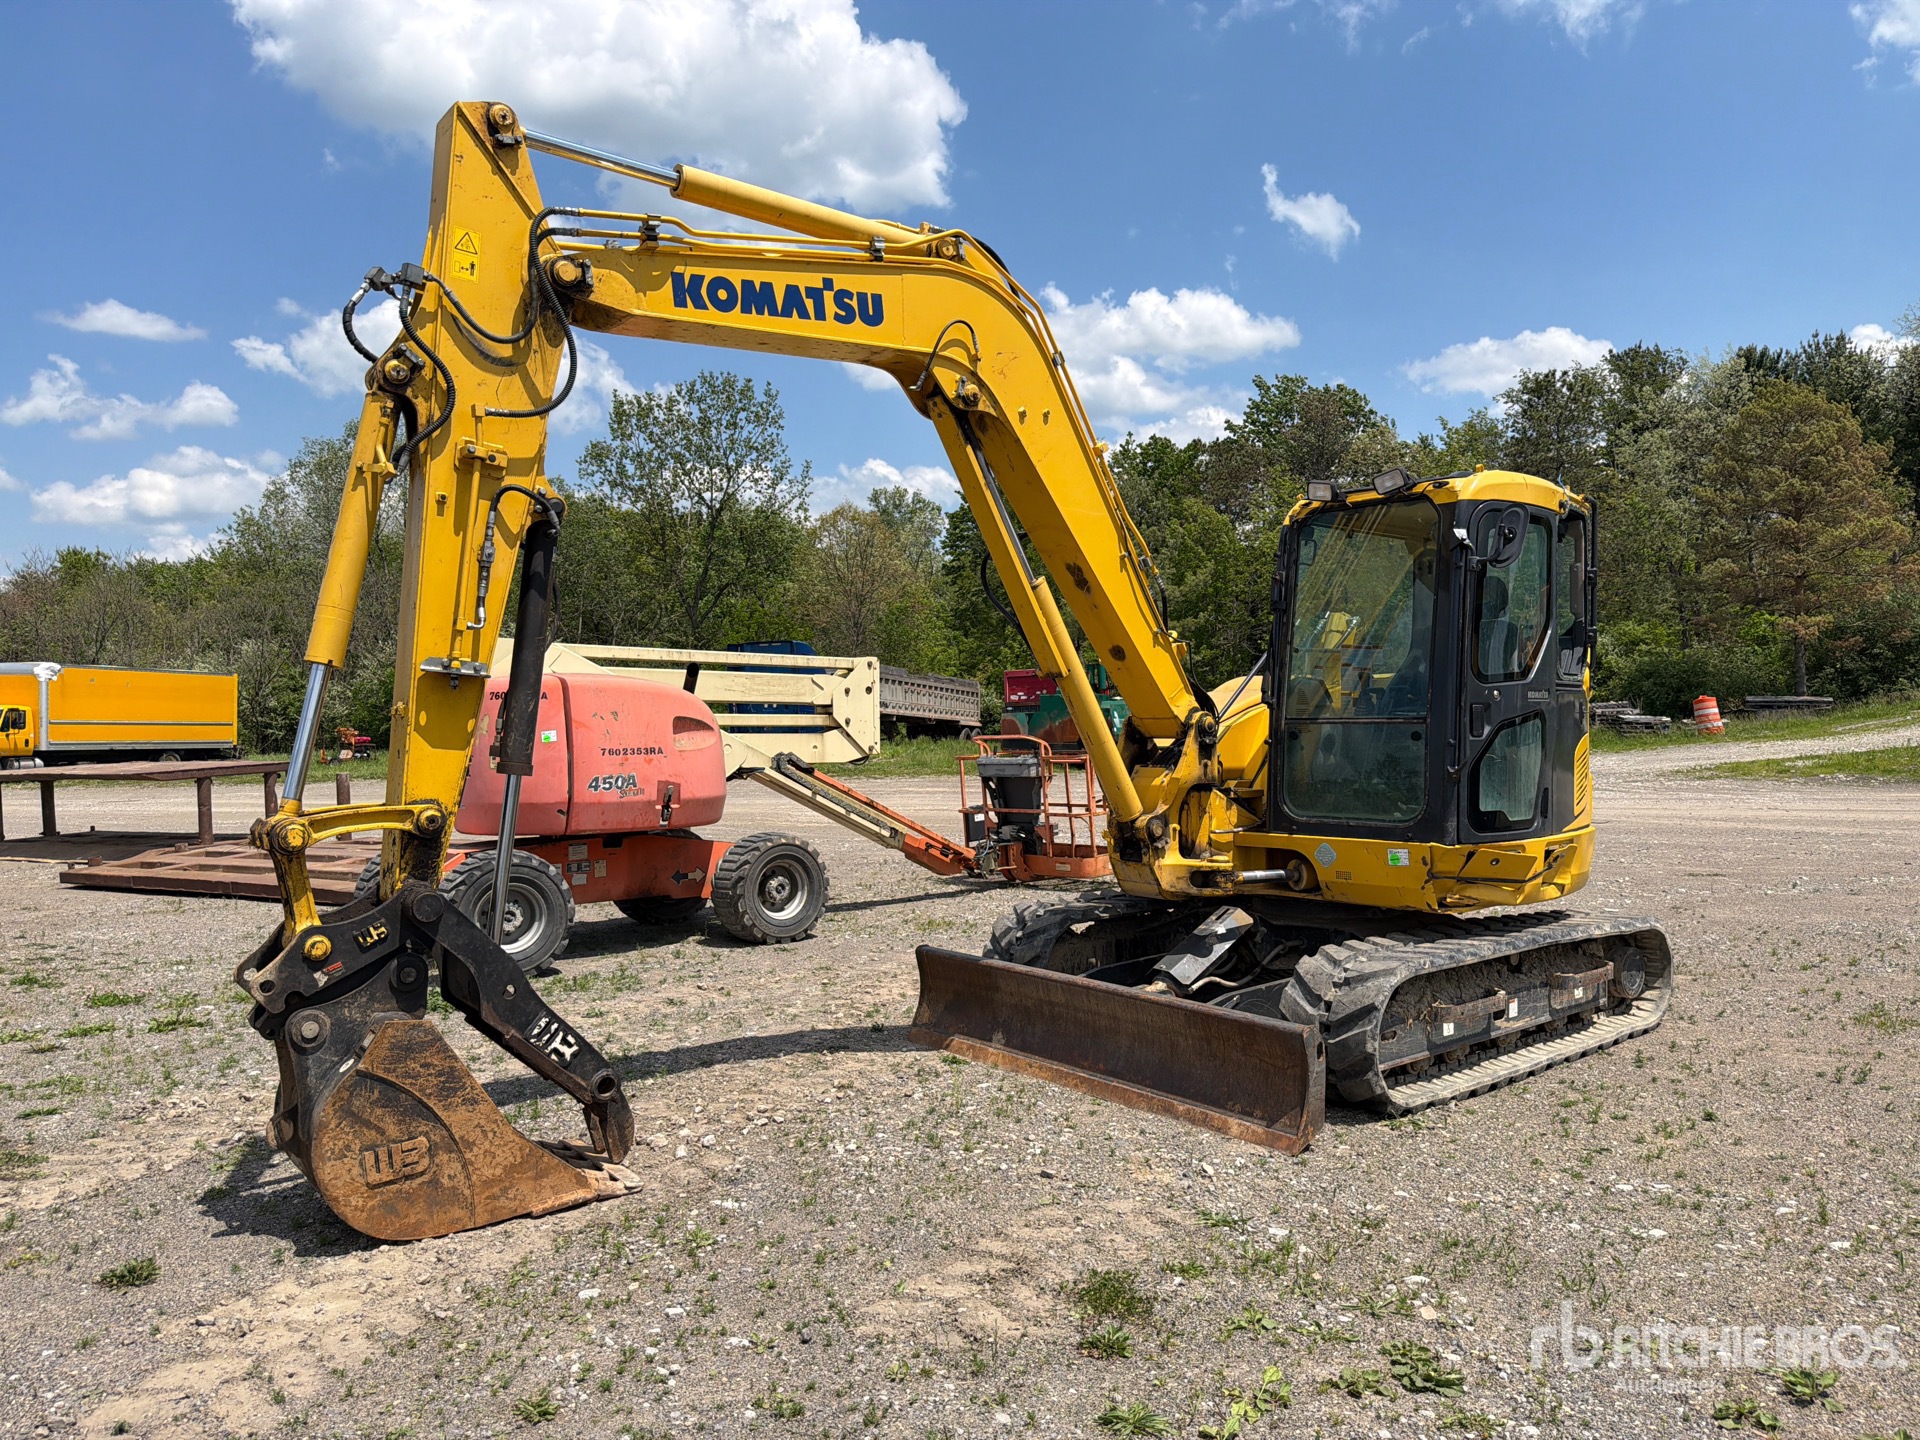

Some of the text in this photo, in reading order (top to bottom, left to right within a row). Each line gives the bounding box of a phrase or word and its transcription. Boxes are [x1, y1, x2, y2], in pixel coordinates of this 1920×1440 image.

[670, 271, 884, 327] KOMATSU
[600, 746, 664, 757] 7602353RA
[587, 773, 638, 793] 450A
